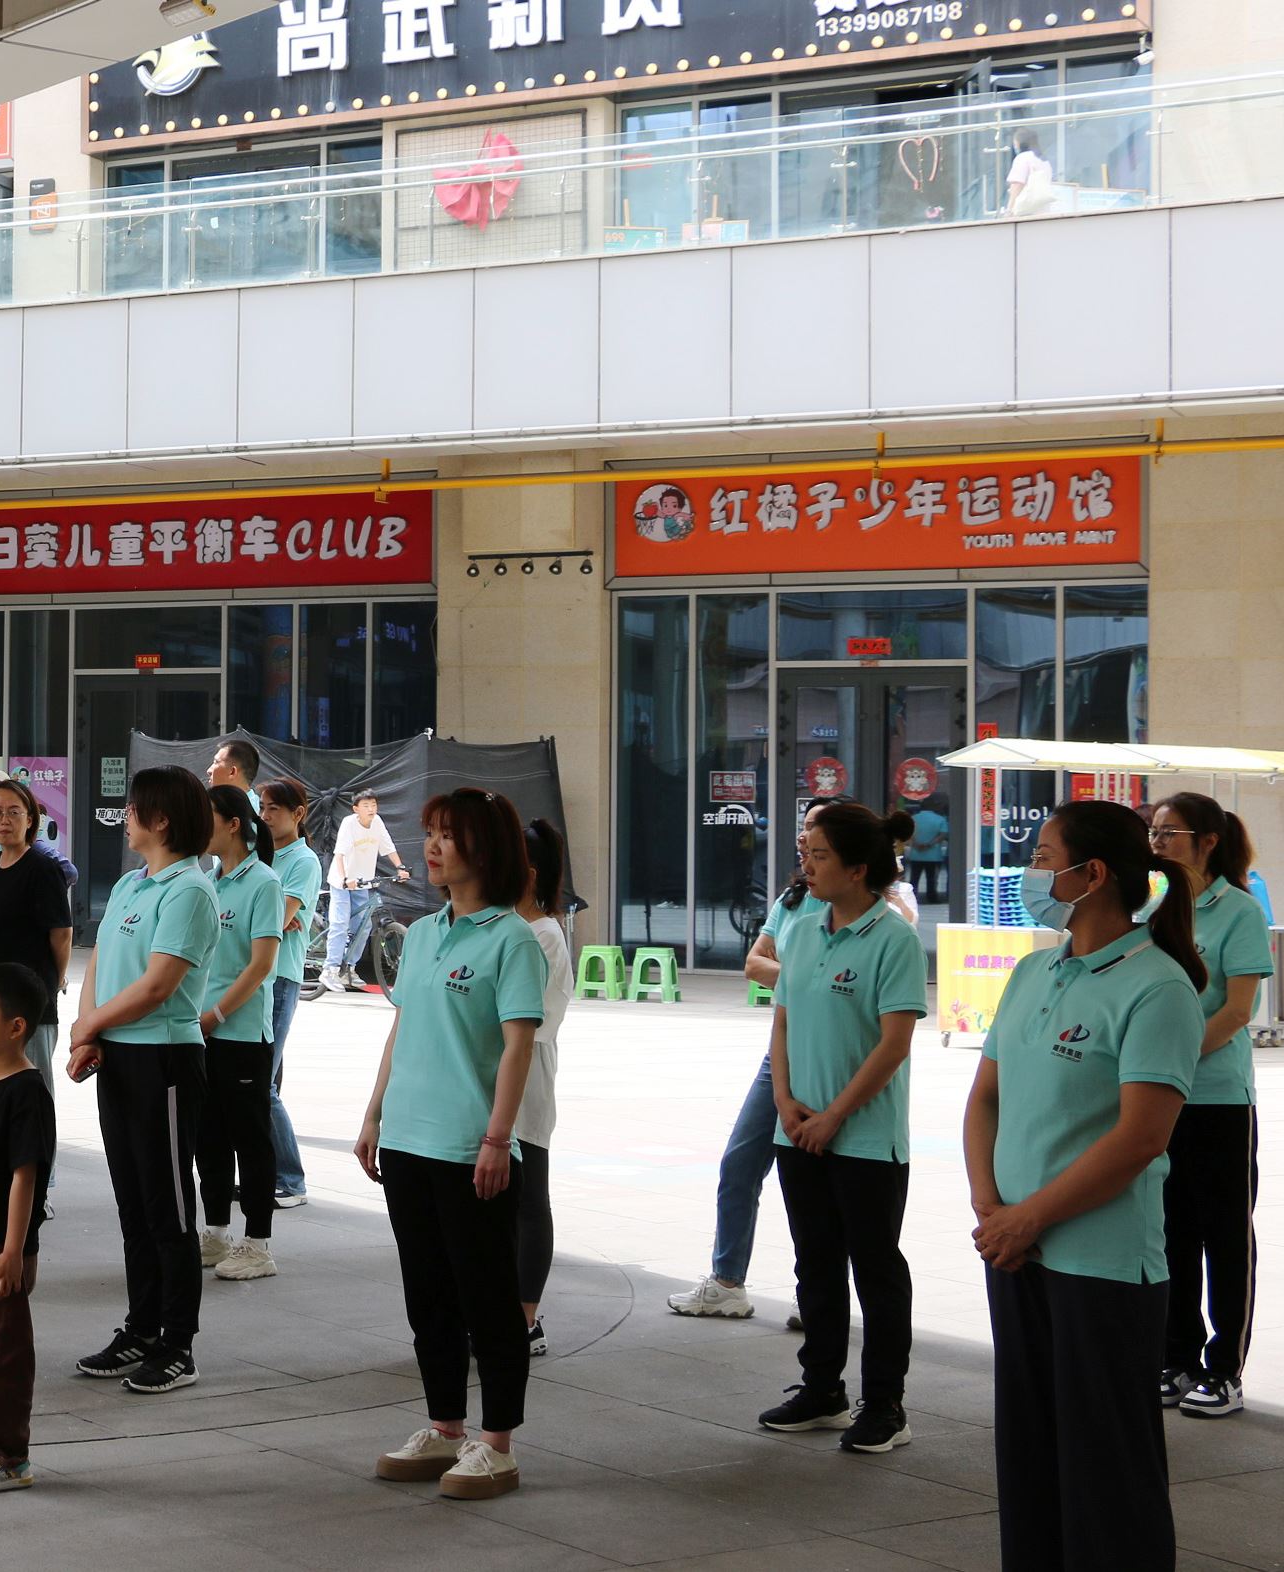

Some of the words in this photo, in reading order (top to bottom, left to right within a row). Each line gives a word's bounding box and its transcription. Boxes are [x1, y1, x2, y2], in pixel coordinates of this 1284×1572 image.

[815, 2, 963, 37] 13399087198
[709, 469, 1114, 535] 红橘子少年运动馆
[286, 515, 407, 561] CLUB
[962, 534, 1014, 549] YOUTH
[1023, 532, 1067, 546] MOVE
[1074, 530, 1116, 544] MENT
[34, 769, 64, 782] 红橘子
[1000, 806, 1049, 820] ello!
